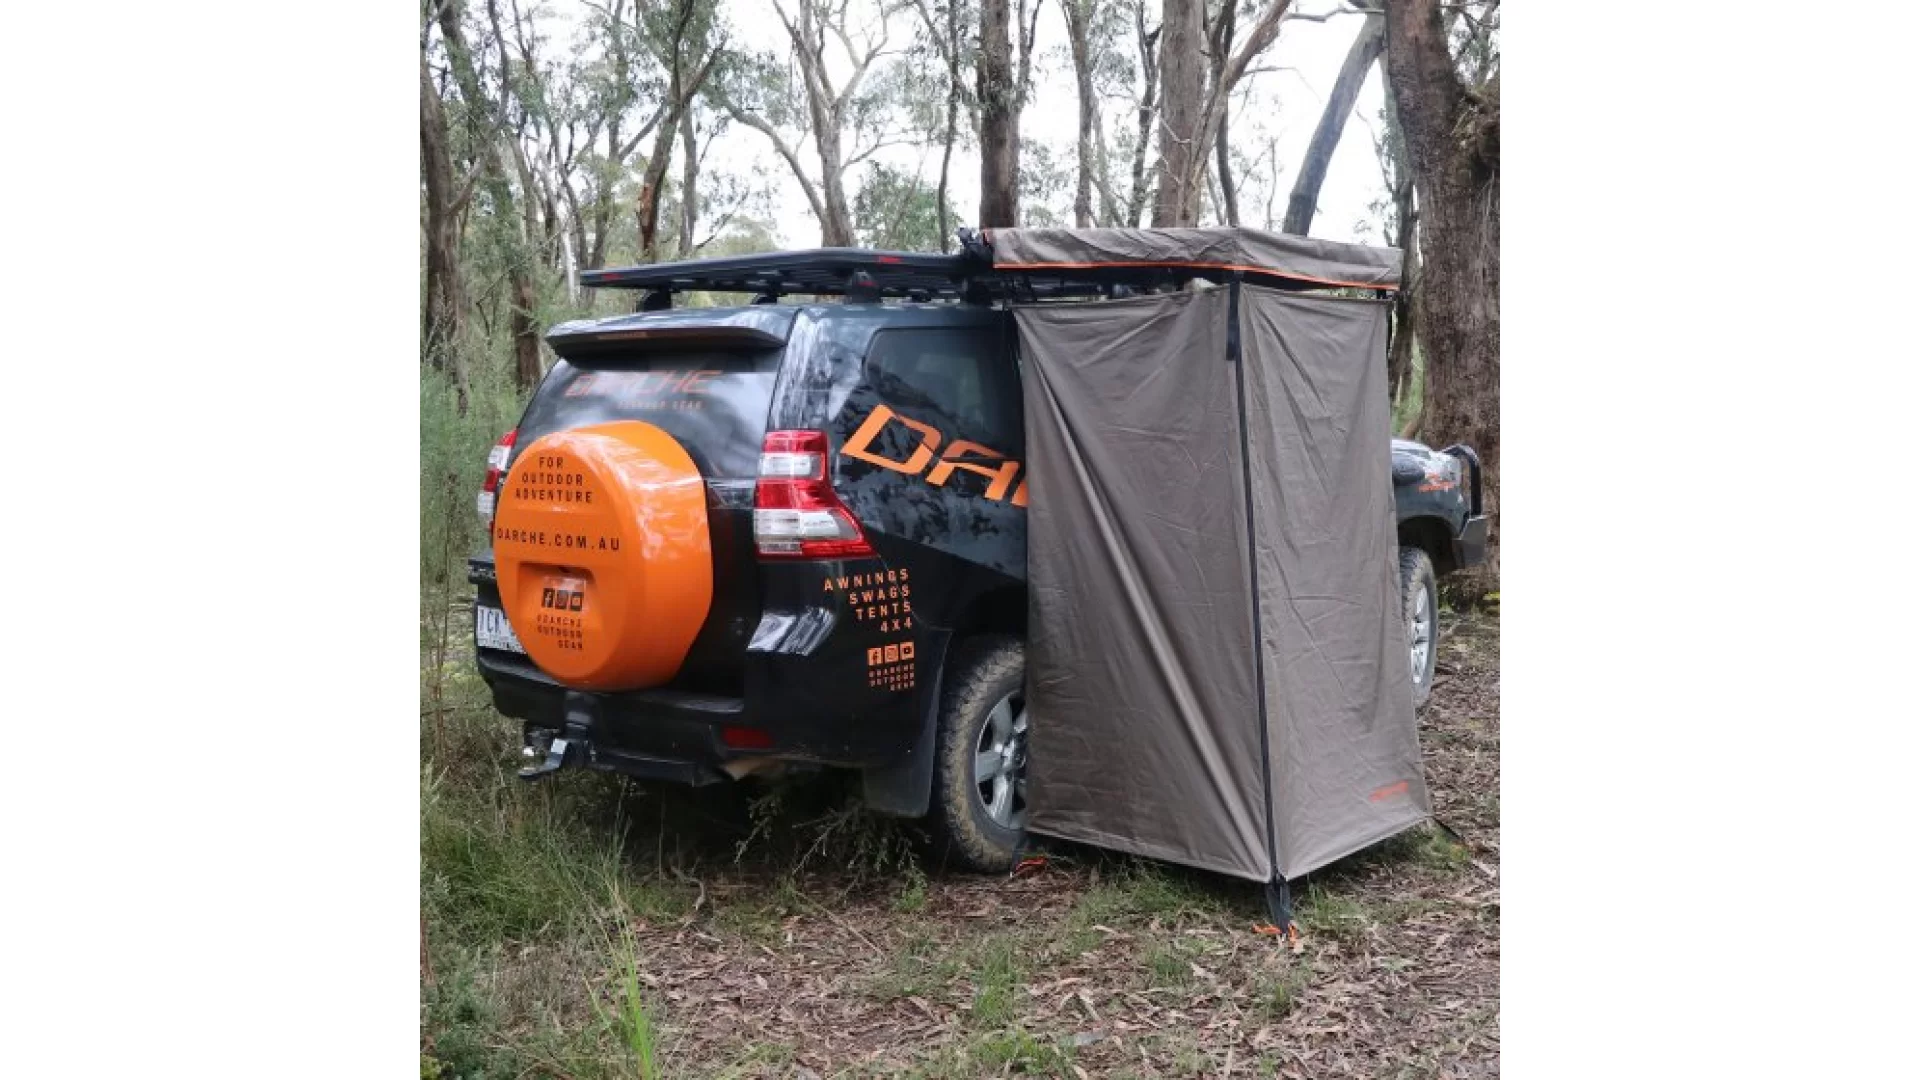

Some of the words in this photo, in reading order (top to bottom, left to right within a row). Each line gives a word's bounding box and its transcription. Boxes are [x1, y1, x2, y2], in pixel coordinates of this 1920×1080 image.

[539, 456, 564, 469] FOR
[522, 472, 583, 487] OUTDOOR
[515, 487, 592, 504] ADVENTURE
[496, 527, 620, 551] DARCHE.COM.AU
[824, 568, 908, 592] AWNINGS
[849, 584, 909, 605] SWAGS
[856, 601, 911, 620] TENTS
